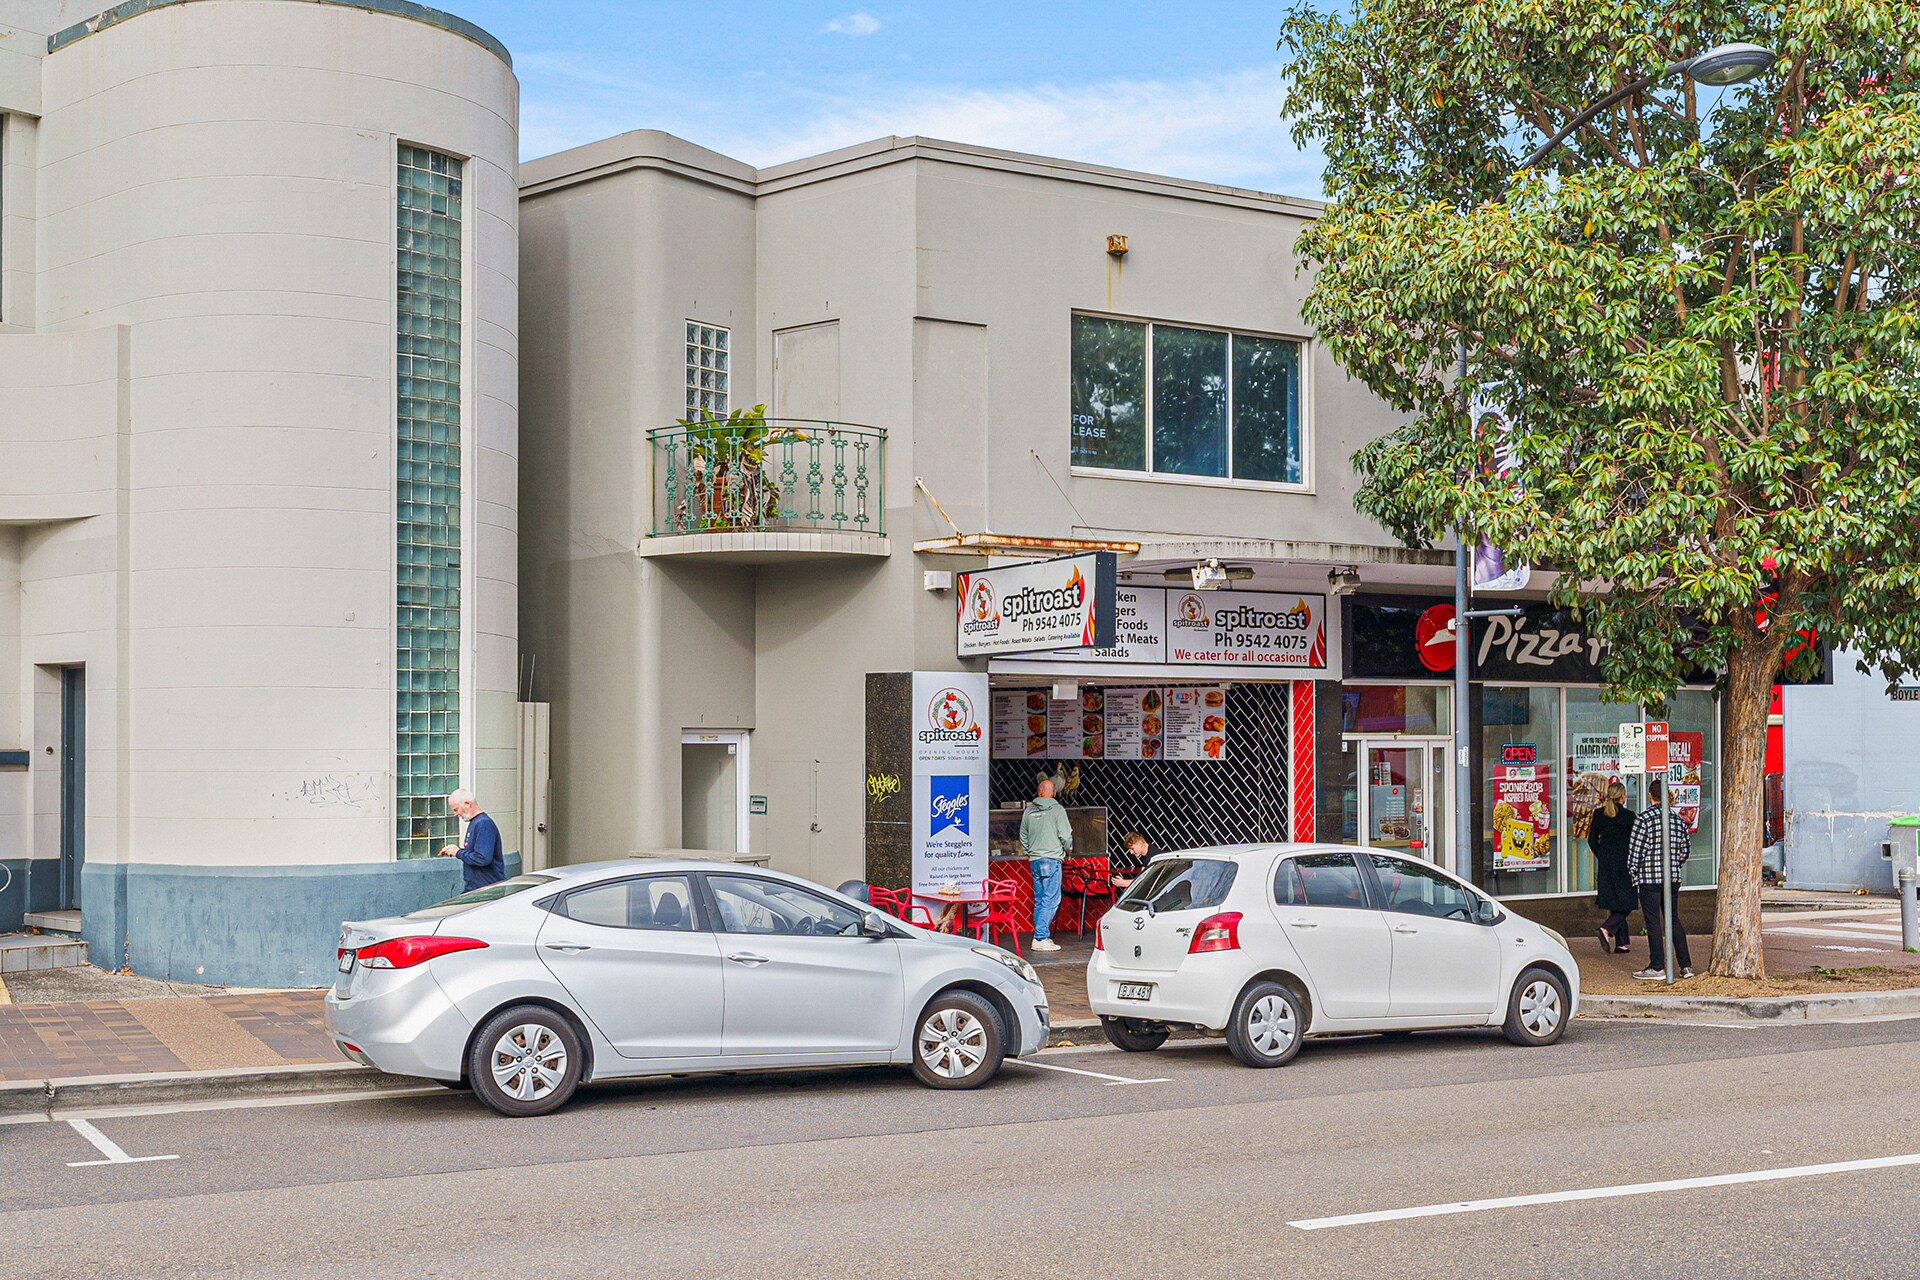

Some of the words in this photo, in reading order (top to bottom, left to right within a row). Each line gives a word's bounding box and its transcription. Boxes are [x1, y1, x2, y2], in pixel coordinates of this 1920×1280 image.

[1072, 414, 1094, 425] FOR
[1072, 426, 1106, 438] LEASE
[1002, 581, 1080, 622] spitroast
[1115, 591, 1137, 602] ken
[1115, 607, 1137, 618] gers
[1022, 618, 1034, 632] Ph
[1036, 615, 1057, 631] 9542
[1059, 612, 1081, 629] 4075
[1116, 619, 1148, 630] Foods
[1173, 618, 1208, 628] spitroast
[1215, 606, 1307, 632] spitroast
[963, 619, 999, 635] spitroast
[1115, 634, 1125, 643] st
[1127, 633, 1159, 644] Meats
[1215, 633, 1232, 647] Ph
[1236, 634, 1271, 648] 9542
[1274, 635, 1307, 649] 4075
[1477, 615, 1584, 667] Pizza
[1095, 647, 1129, 657] Salads
[1174, 649, 1191, 660] We
[1194, 651, 1221, 661] cater
[1224, 650, 1239, 661] for
[1241, 650, 1254, 662] all
[1257, 652, 1307, 663] occasions
[1892, 690, 1919, 700] BOYLE
[1633, 726, 1644, 739] P
[1651, 725, 1662, 733] NO
[918, 728, 979, 744] spitroast
[1503, 747, 1535, 761] OPEN
[1576, 744, 1600, 758] LOADED
[1601, 744, 1620, 758] COOK
[1669, 764, 1682, 782] $19
[1499, 782, 1544, 793] SPONGEBOB
[931, 793, 969, 820] Steggles
[944, 841, 973, 849] Stegglers
[934, 850, 957, 859] quality
[957, 851, 975, 859] time
